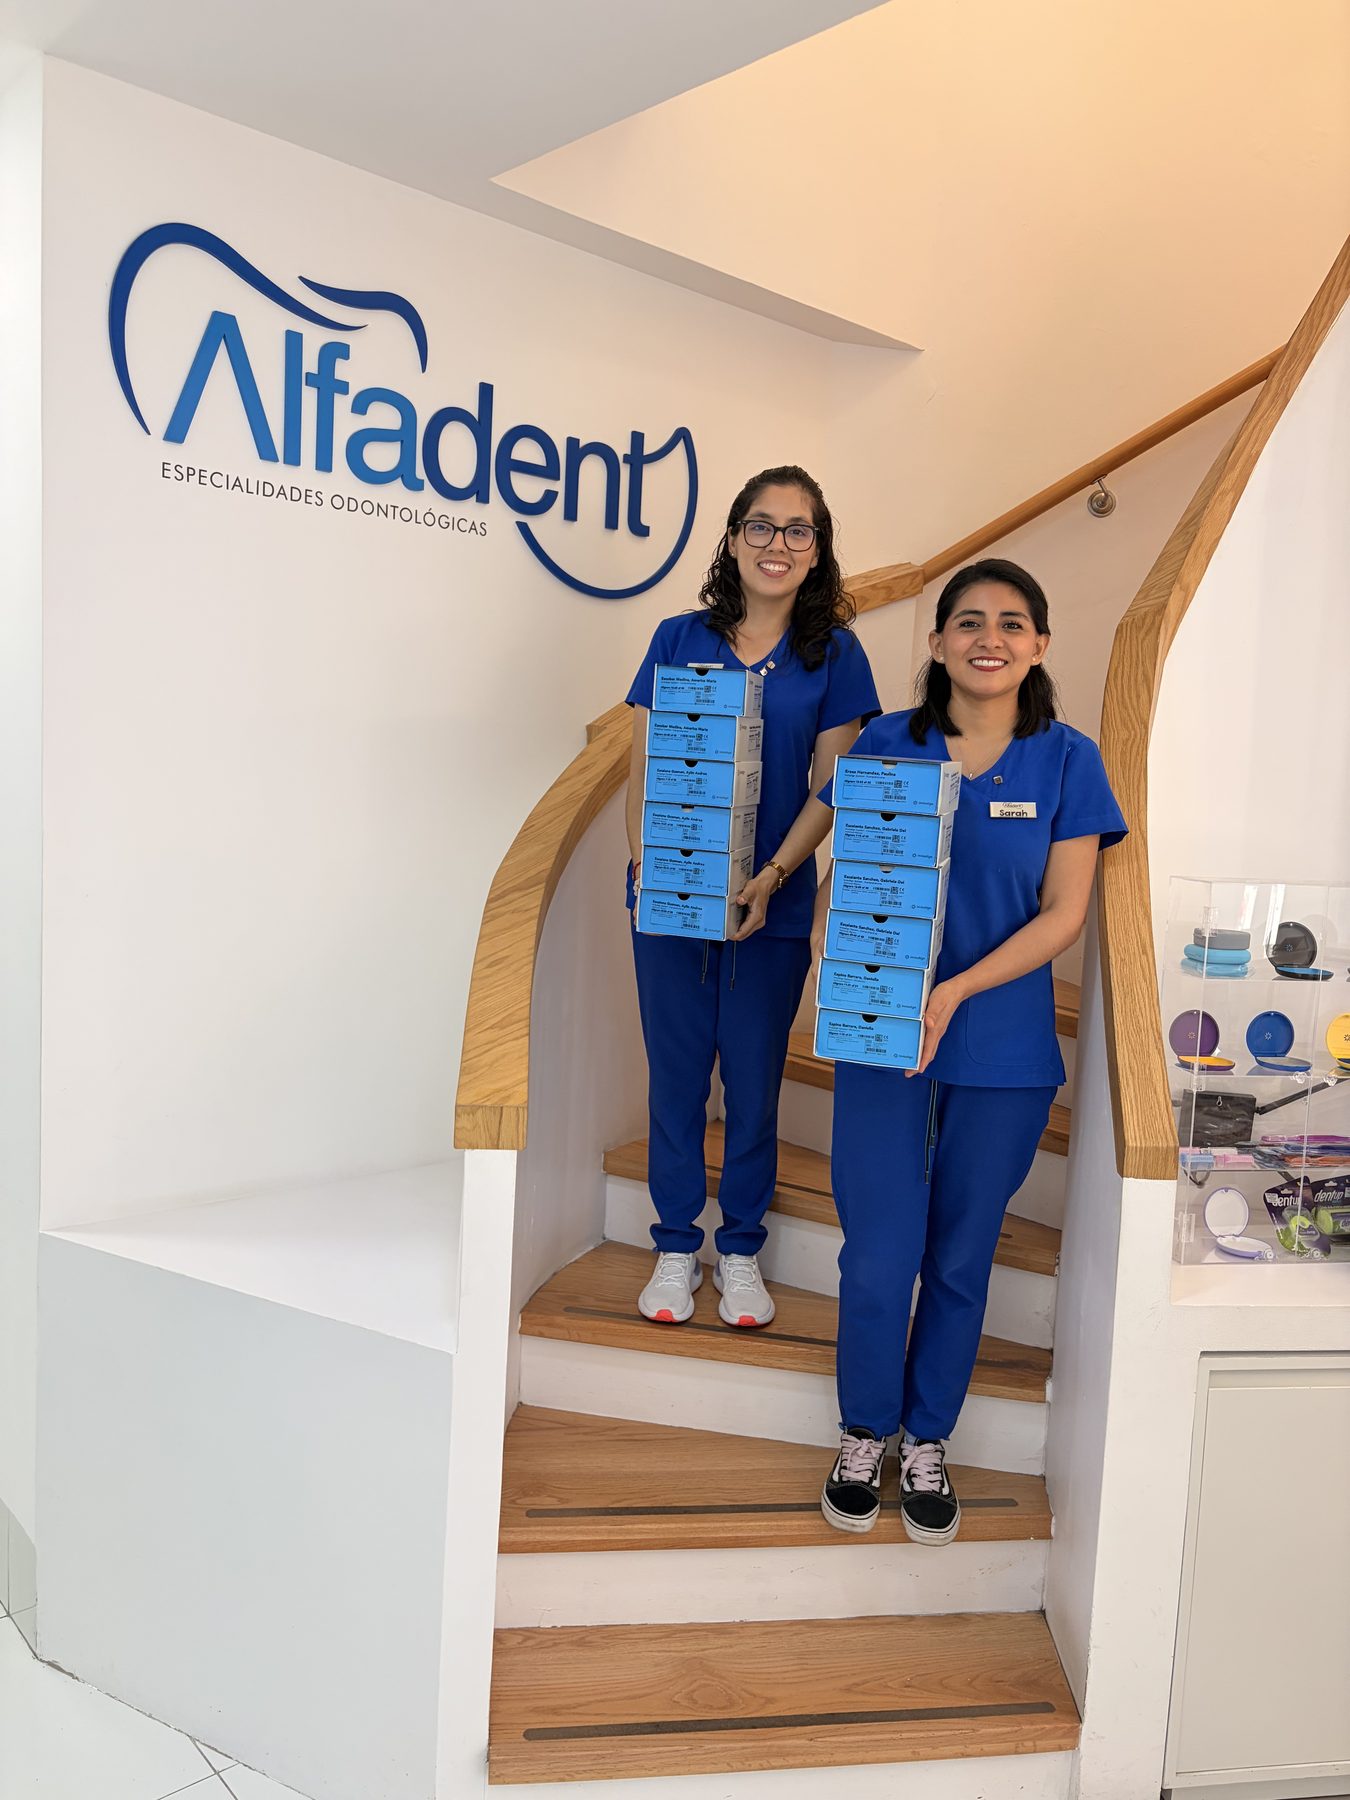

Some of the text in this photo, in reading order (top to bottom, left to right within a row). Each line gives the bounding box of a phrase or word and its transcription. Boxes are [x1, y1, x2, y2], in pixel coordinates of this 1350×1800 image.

[162, 310, 650, 538] Alfadent
[161, 461, 488, 537] ESPECIALIDADES ODONTOLÓGICAS
[1314, 1190, 1344, 1202] dentup
